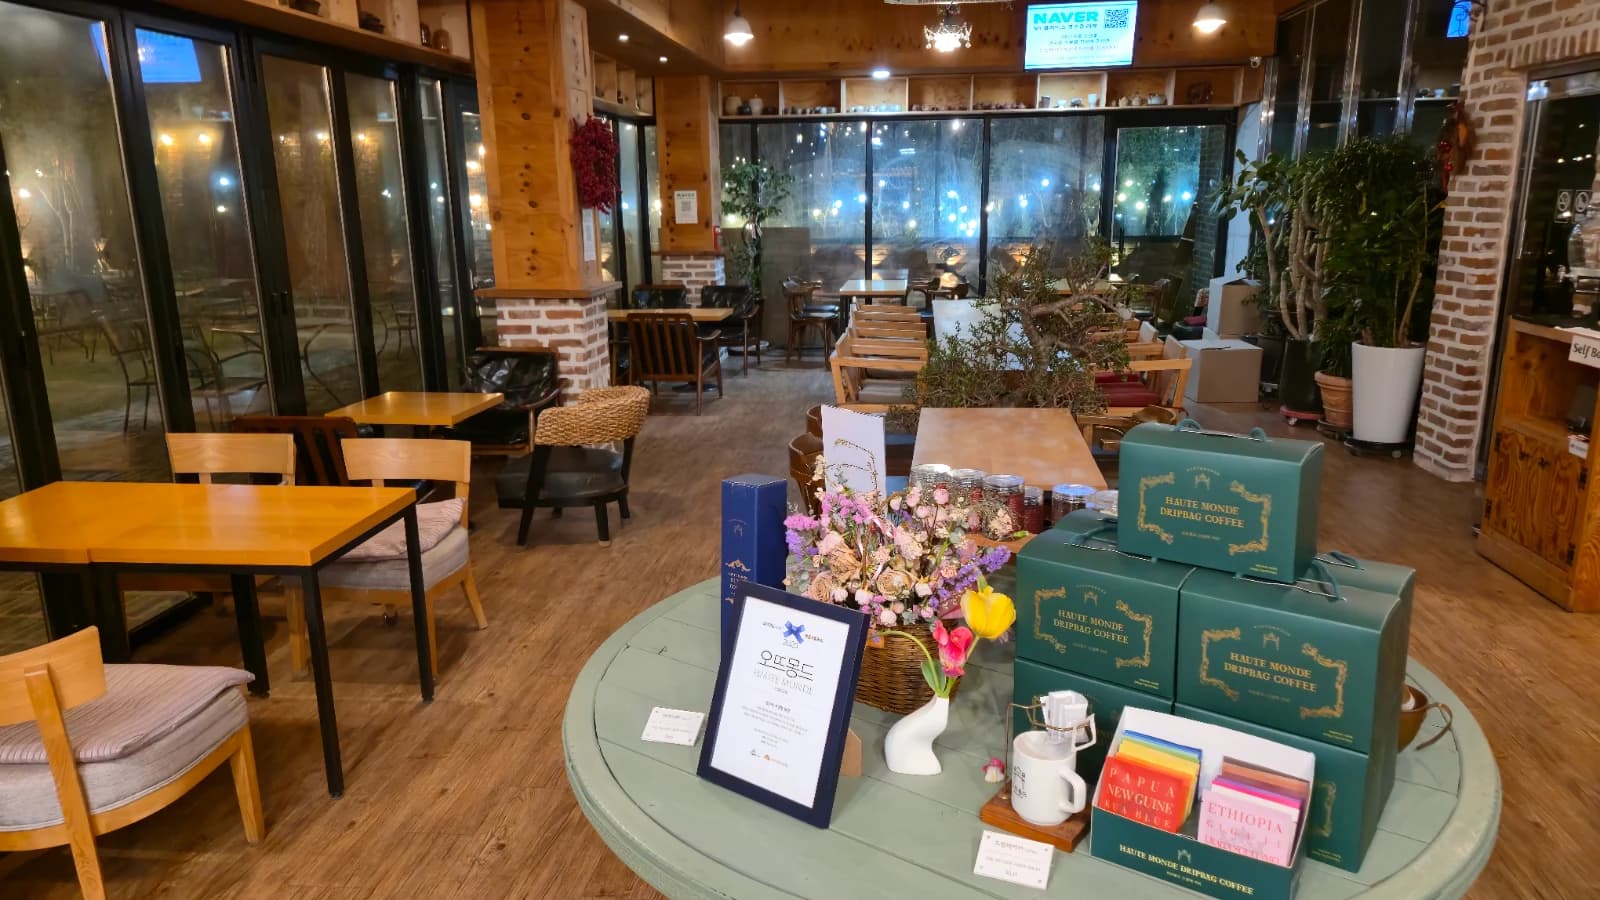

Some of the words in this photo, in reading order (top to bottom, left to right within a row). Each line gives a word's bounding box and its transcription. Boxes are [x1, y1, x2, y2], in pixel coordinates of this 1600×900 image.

[1033, 11, 1099, 24] NAVER
[1572, 343, 1591, 358] Self
[1160, 507, 1201, 520] DRIPBAG
[1205, 514, 1244, 528] COFFEE
[1165, 496, 1198, 508] HAUTE
[1201, 502, 1239, 515] MONDE
[1053, 618, 1091, 633] DRIPBAG
[1093, 628, 1128, 644] COFFEE
[1058, 609, 1087, 622] HAUTE
[1090, 617, 1125, 631] MONDE
[1224, 662, 1270, 680] DRIPBAG
[1273, 675, 1317, 692] COFFEE
[1230, 652, 1266, 667] HAUTE
[1269, 661, 1311, 678] MONDE
[1108, 784, 1133, 800] NEW
[1110, 767, 1175, 799] PAPUA
[1208, 802, 1283, 833] ETHIOPIA
[1119, 844, 1146, 860] HAUTE
[1148, 854, 1178, 871] MONDE
[1180, 865, 1217, 883] DRIPBAG
[1219, 878, 1254, 895] COFFEE
